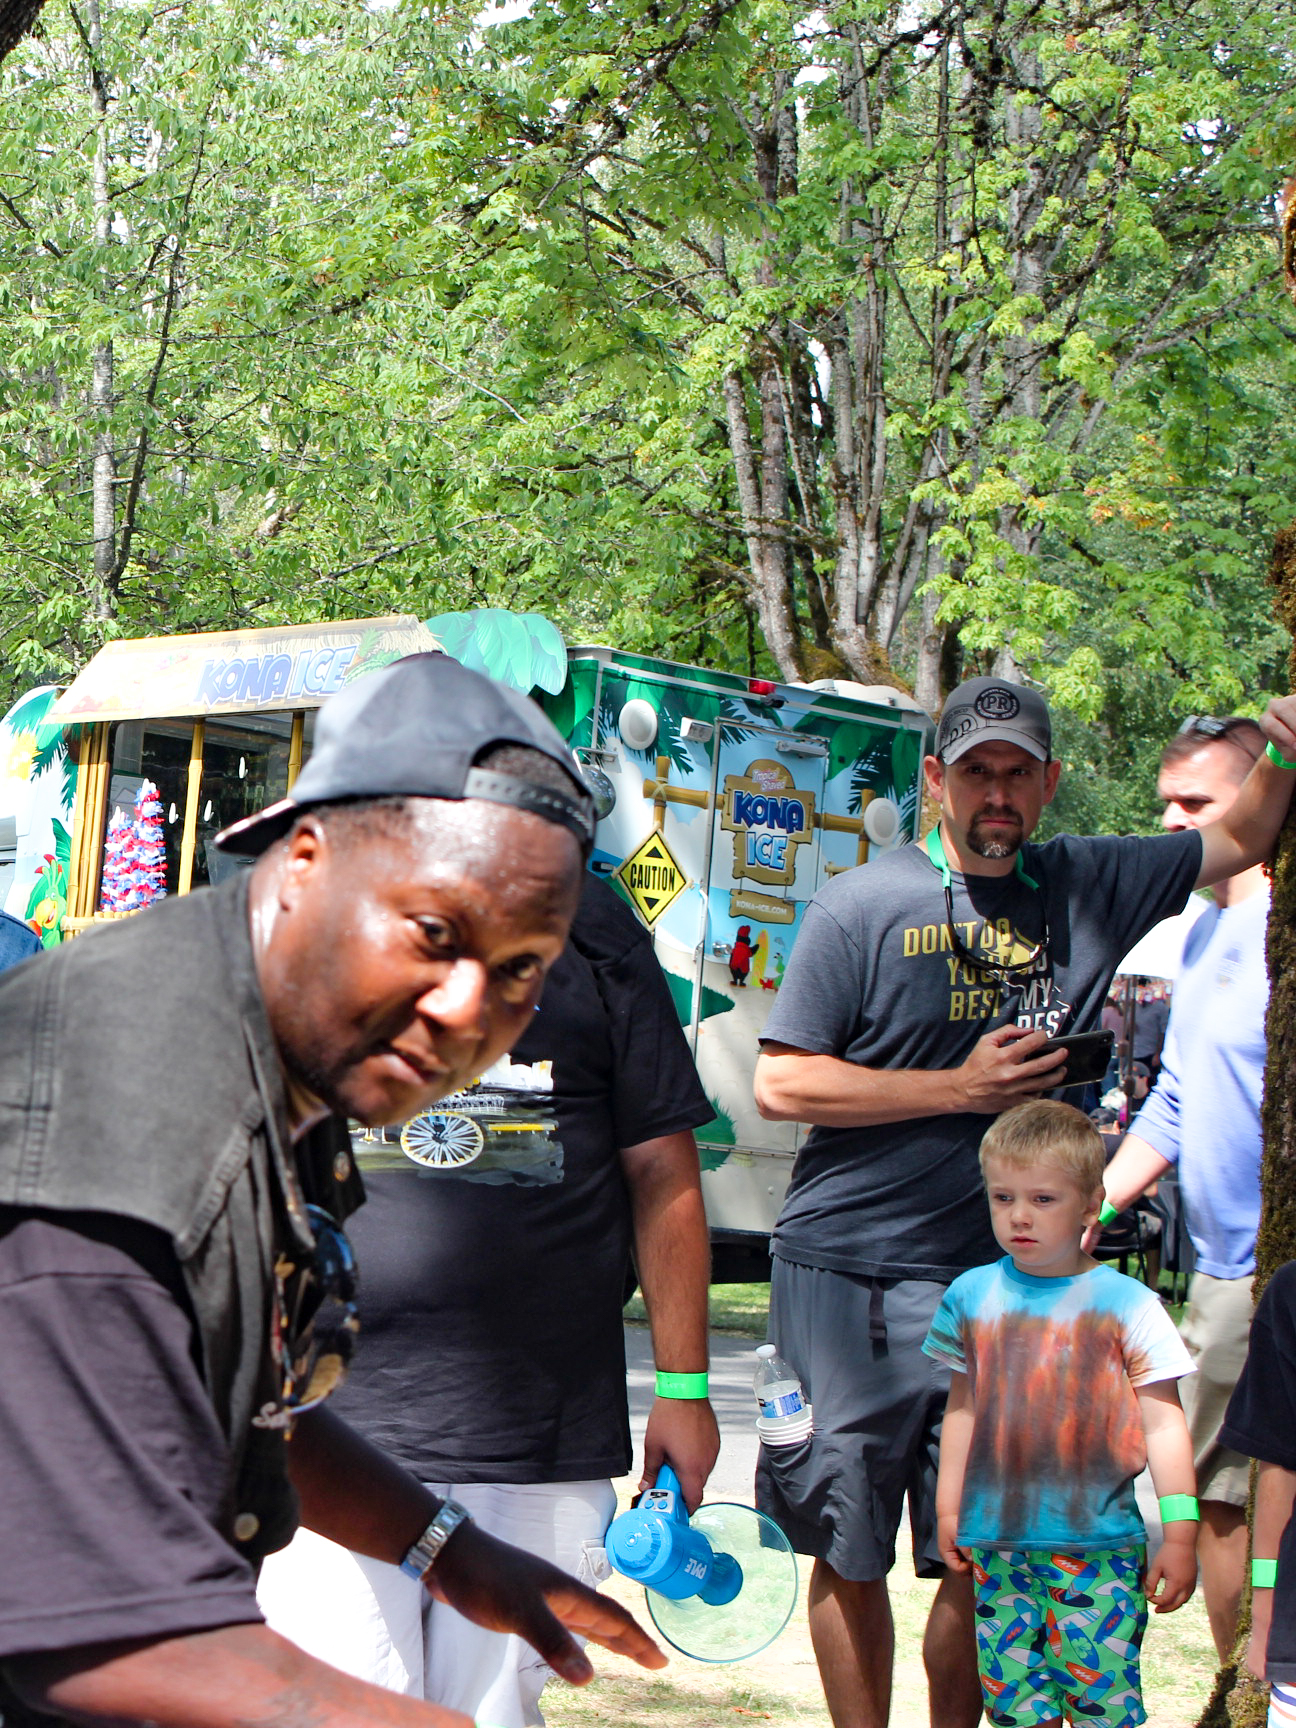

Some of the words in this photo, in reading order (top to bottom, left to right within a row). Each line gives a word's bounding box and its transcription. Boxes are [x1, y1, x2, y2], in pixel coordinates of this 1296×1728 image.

[194, 654, 292, 706] KONA
[290, 645, 357, 698] ICE
[984, 695, 1009, 711] PR
[733, 789, 805, 835] KONA
[746, 831, 789, 871] ICE
[630, 863, 675, 892] CAUTION
[904, 921, 978, 957] DON'T
[979, 917, 1010, 950] DO
[949, 988, 1004, 1021] BEST
[1018, 977, 1052, 1010] MY
[684, 1558, 707, 1579] PYLE
